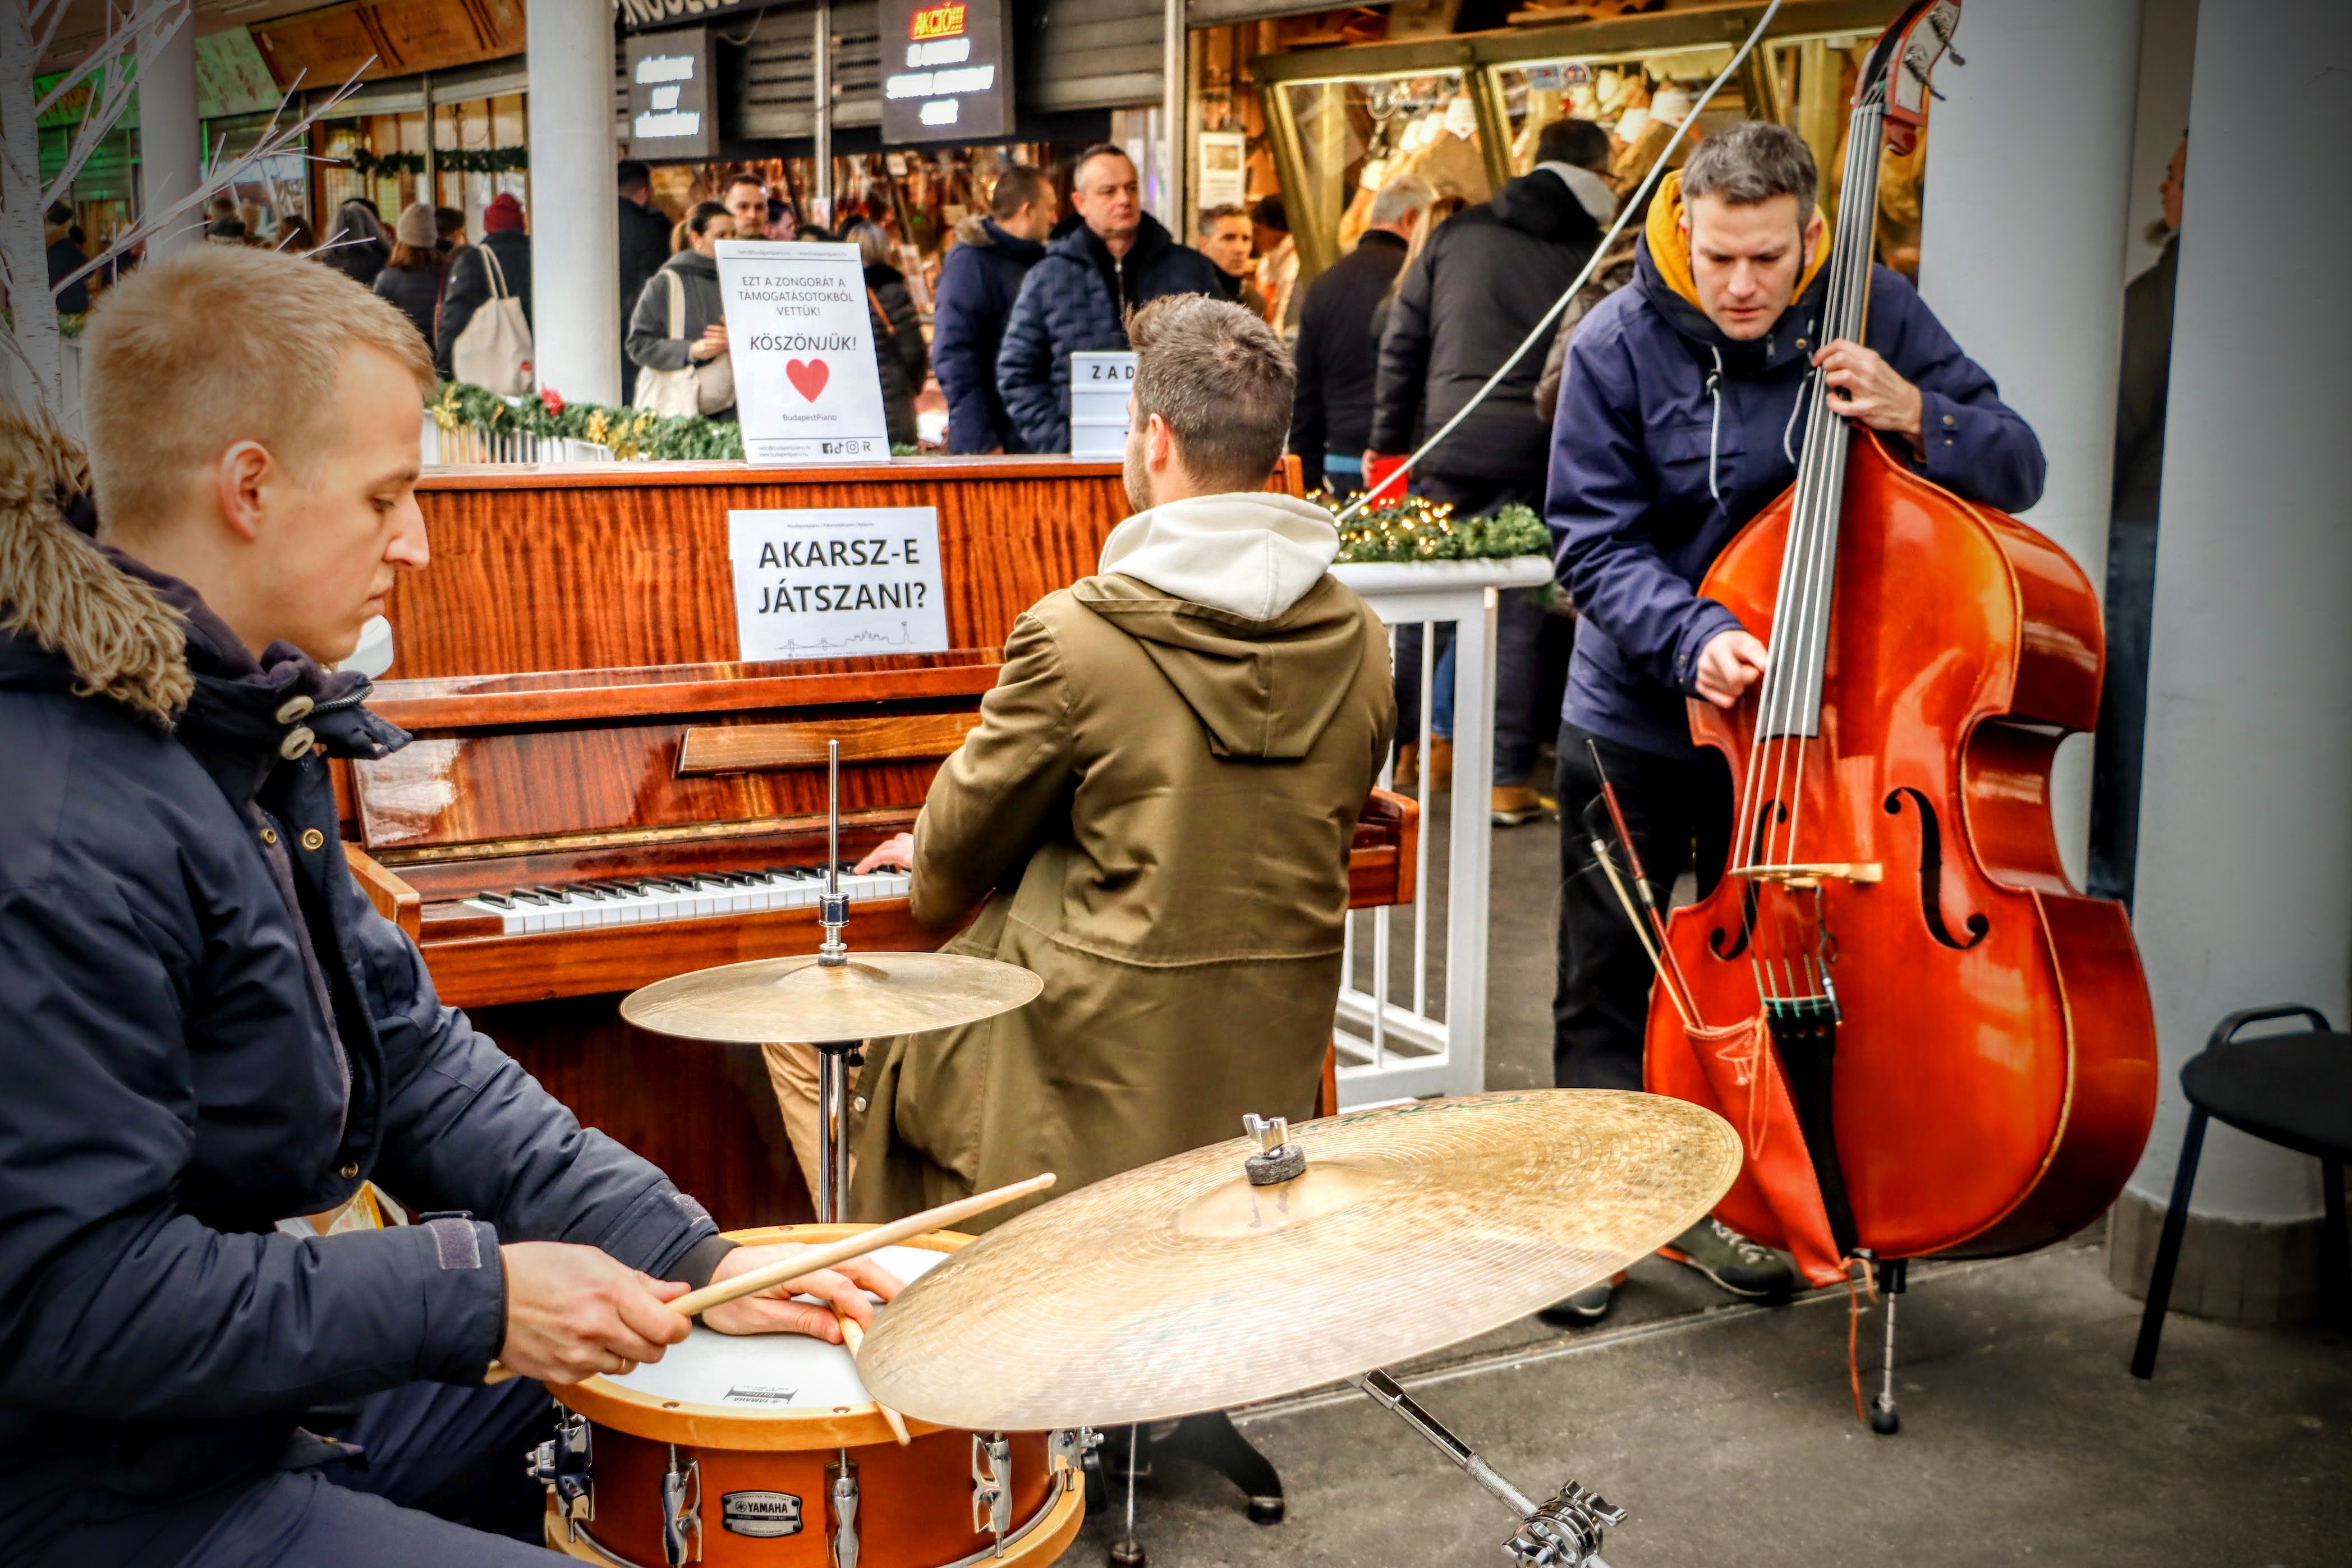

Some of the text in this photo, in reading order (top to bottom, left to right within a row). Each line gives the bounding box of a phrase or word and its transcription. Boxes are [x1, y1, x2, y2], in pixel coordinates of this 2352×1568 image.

[742, 275, 846, 287] EZT A ZONGORÁT A
[738, 288, 854, 302] TÁMOGATÁSOTOKBÓL
[777, 305, 821, 316] VETTÜK!
[750, 333, 857, 351] KÖSZÖNJÜK!
[783, 413, 837, 422] BudapestPiano
[759, 538, 920, 569] AKARSZ-E
[758, 578, 927, 614] JÁTSZANI?
[748, 1502, 788, 1512] YAMAHA
